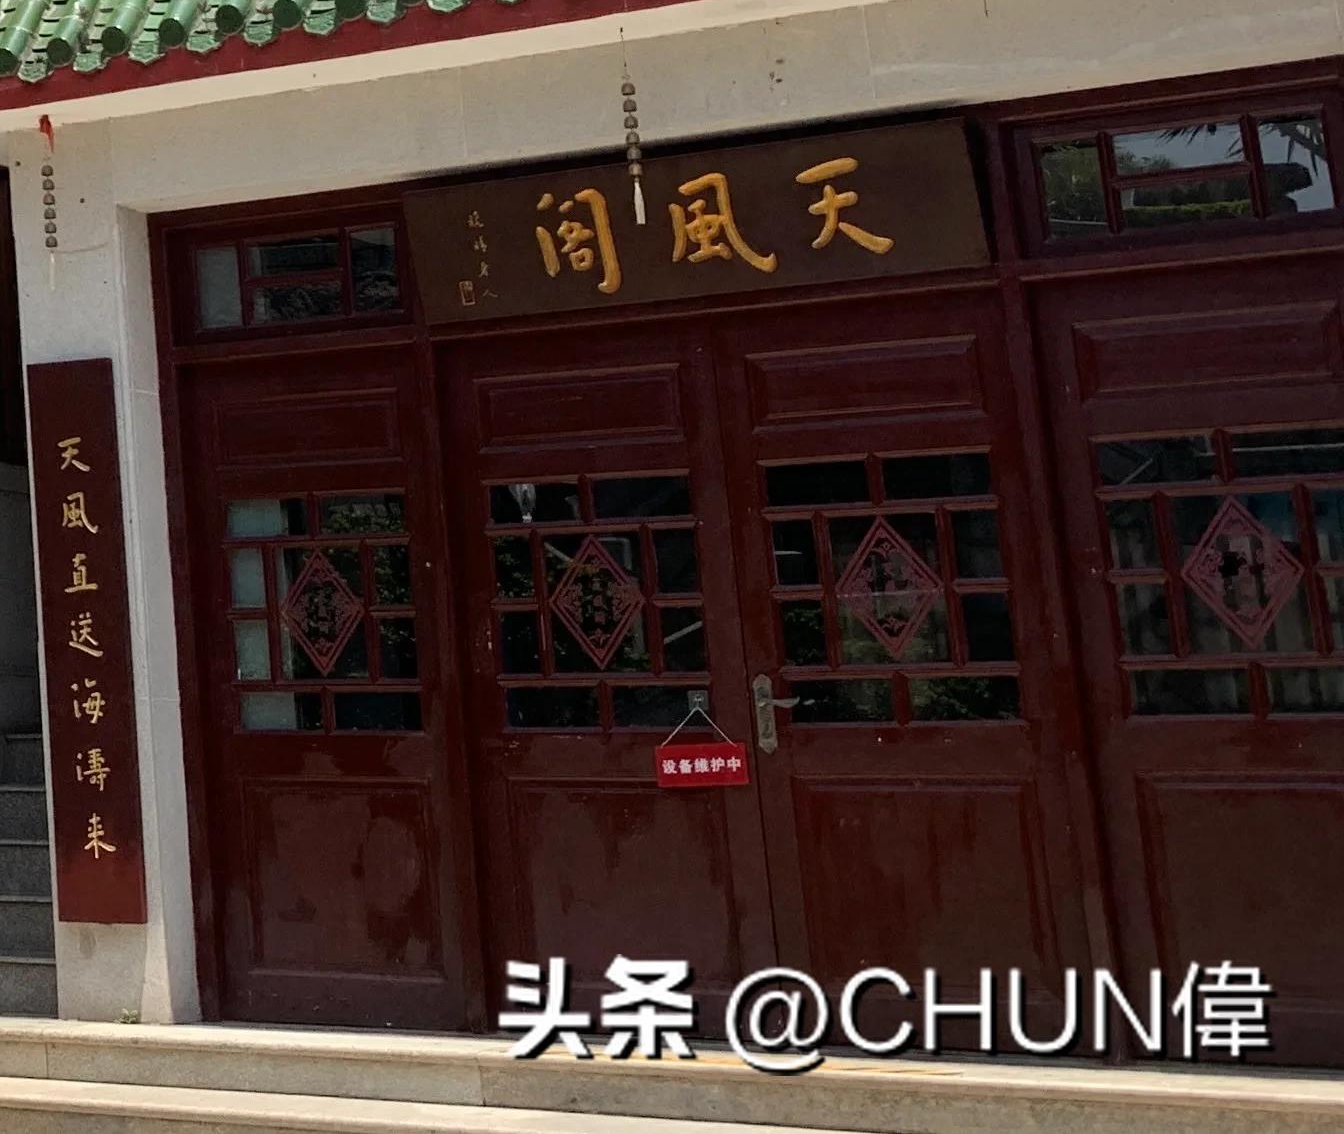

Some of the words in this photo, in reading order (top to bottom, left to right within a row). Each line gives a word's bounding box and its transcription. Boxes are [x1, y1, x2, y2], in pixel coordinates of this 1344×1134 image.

[661, 756, 742, 774] 设备维护中
